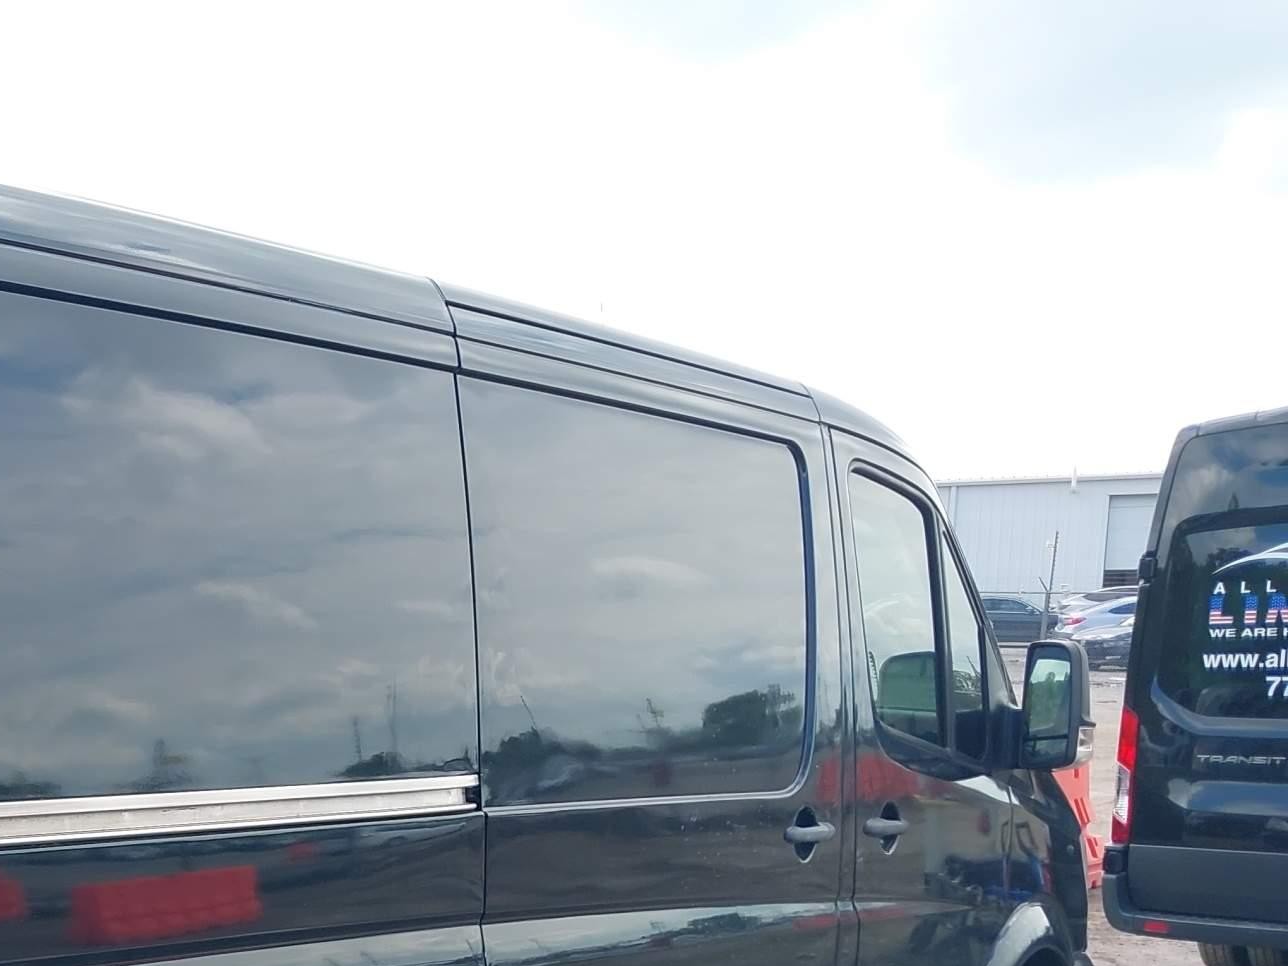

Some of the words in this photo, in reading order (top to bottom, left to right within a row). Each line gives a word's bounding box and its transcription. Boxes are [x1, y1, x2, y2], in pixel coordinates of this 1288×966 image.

[1208, 628, 1237, 638] WE
[1241, 627, 1278, 638] ARE
[1202, 648, 1288, 668] www.al
[1196, 754, 1287, 765] TRANSIT
